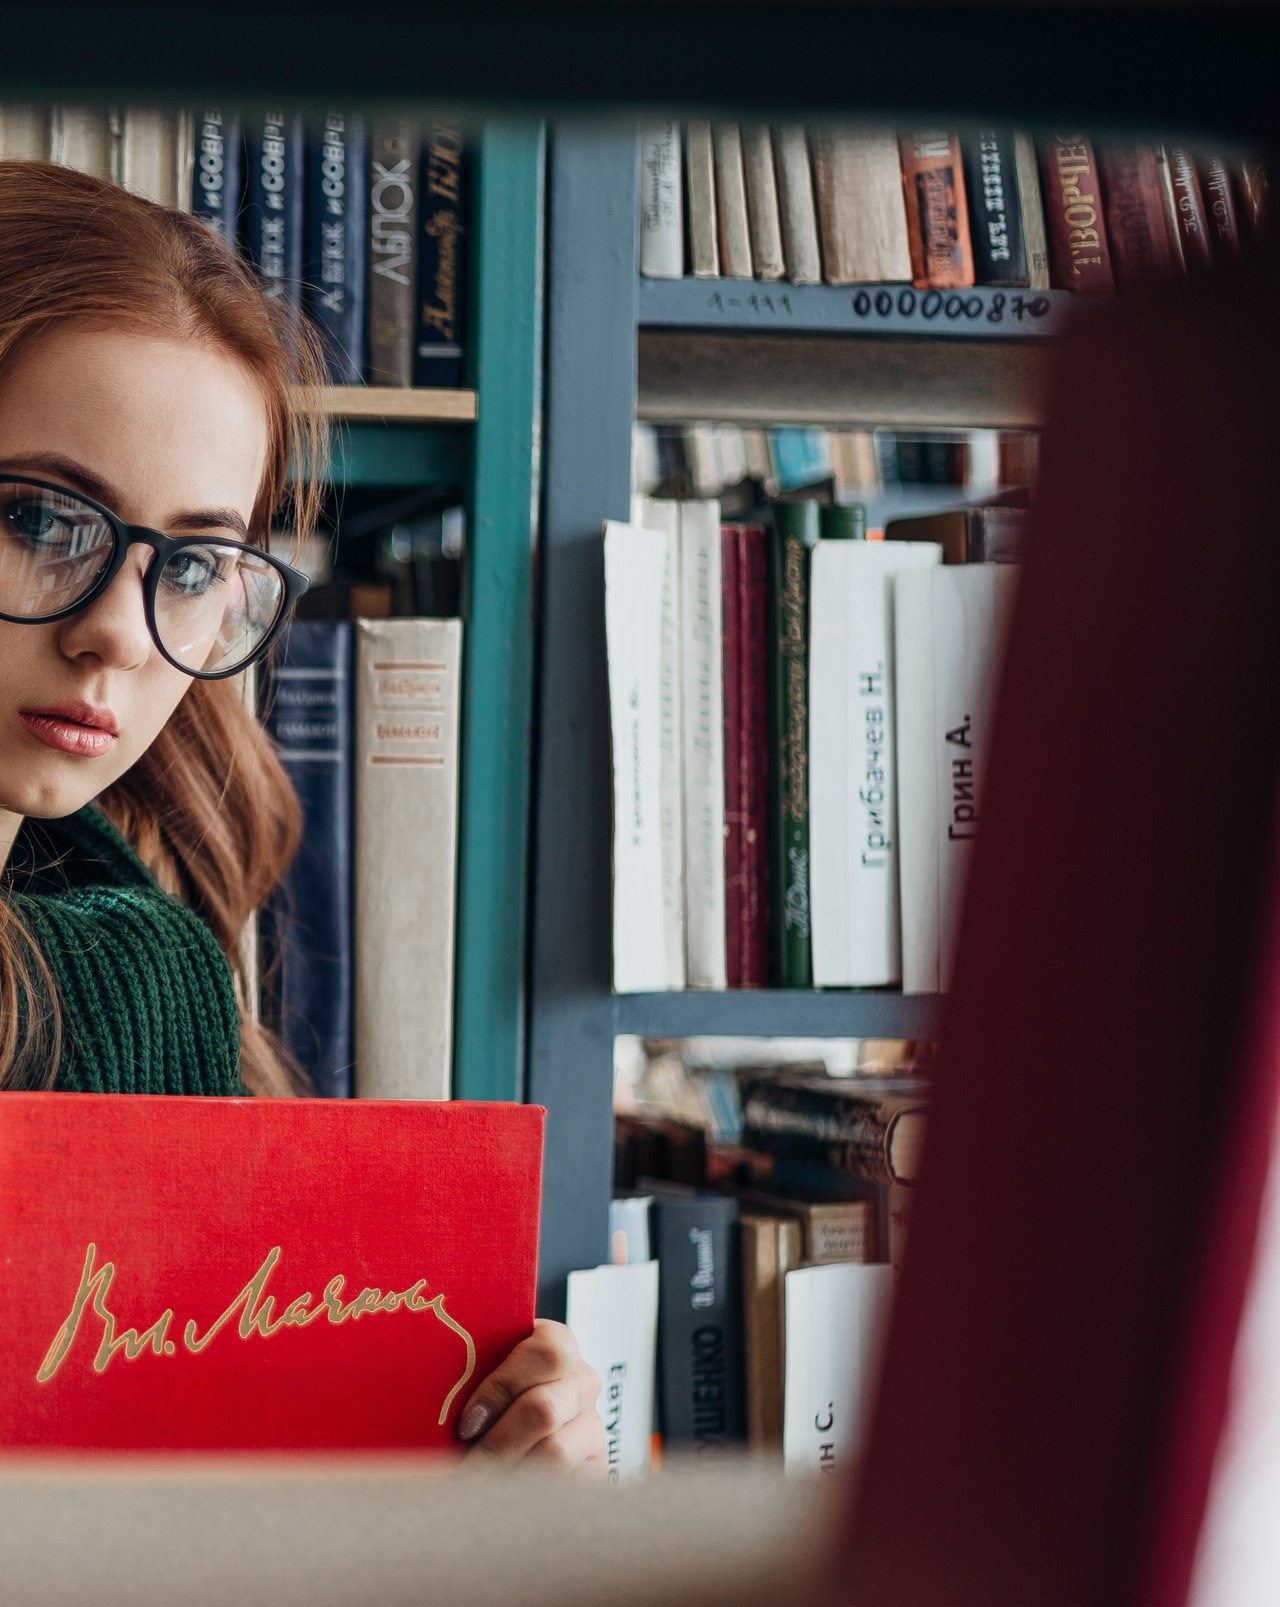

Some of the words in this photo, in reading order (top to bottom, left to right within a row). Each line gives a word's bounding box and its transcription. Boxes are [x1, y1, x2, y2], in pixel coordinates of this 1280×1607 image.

[860, 660, 884, 697] Н.
[945, 714, 972, 749] А.
[859, 705, 891, 868] Грибачев
[948, 758, 980, 842] Грин
